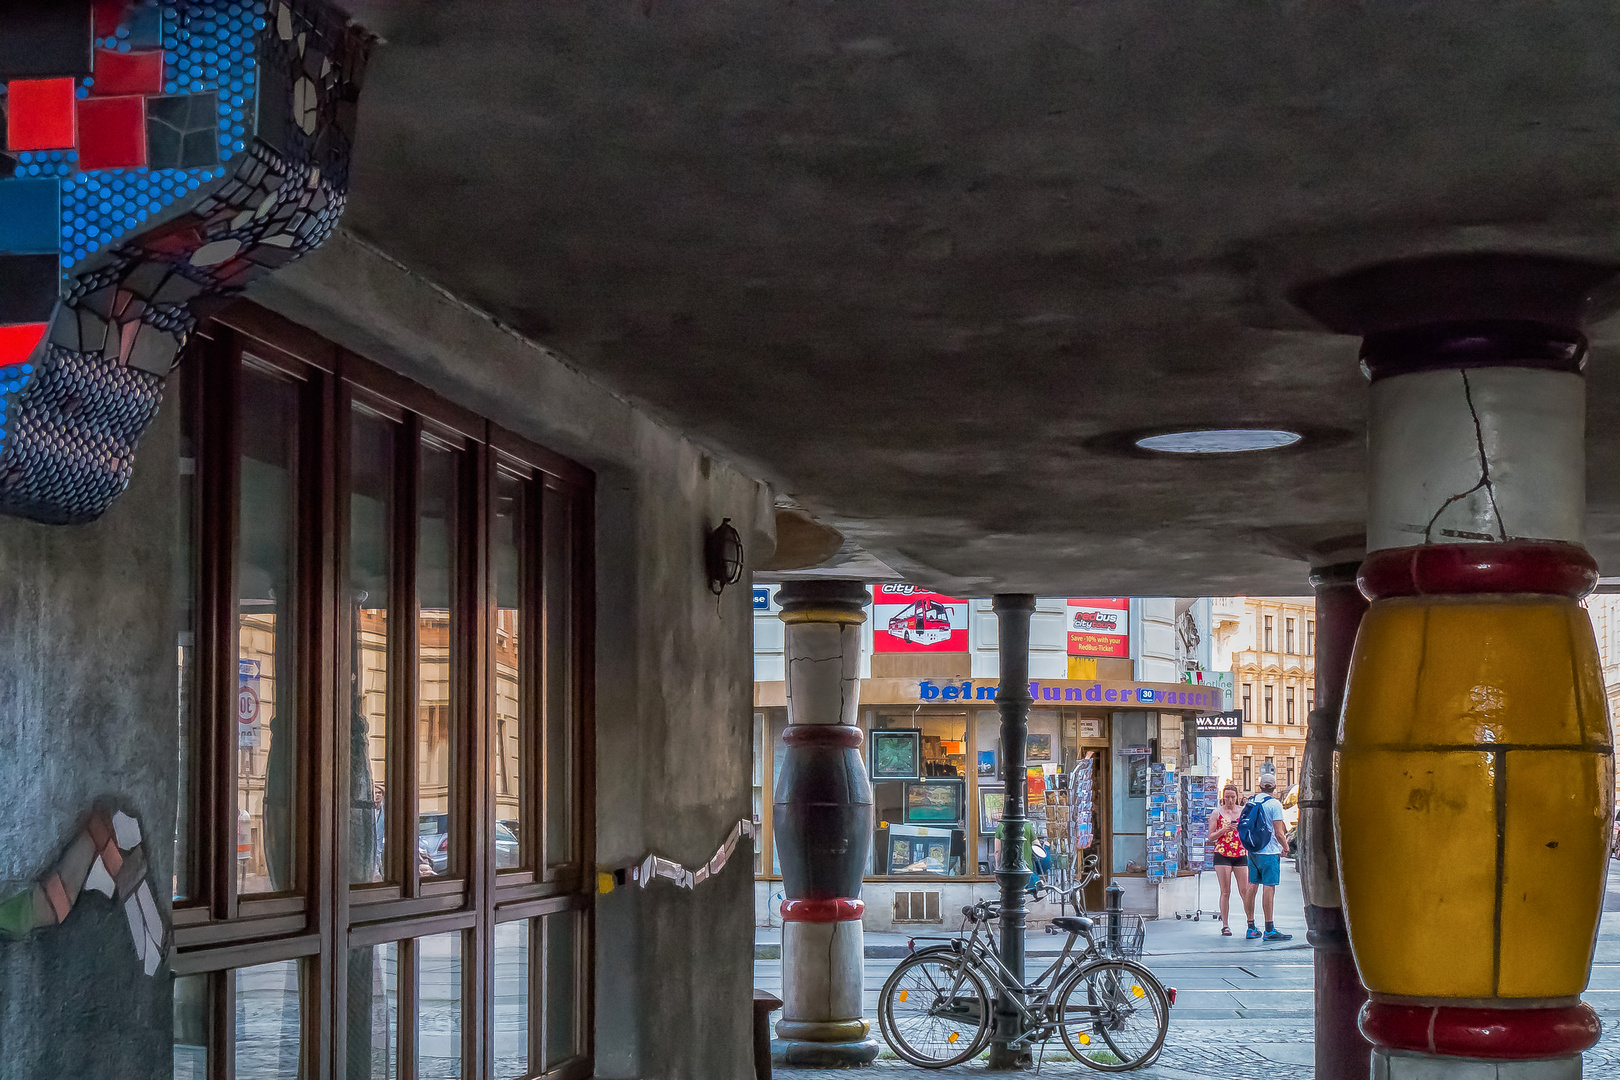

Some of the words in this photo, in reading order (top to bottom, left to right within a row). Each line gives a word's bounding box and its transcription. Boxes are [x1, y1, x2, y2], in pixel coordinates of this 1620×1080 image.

[1075, 611, 1117, 622] redbus
[1071, 634, 1083, 642] Save
[1084, 635, 1096, 643] -10%
[1078, 643, 1114, 652] RedBus-Ticket
[1142, 690, 1153, 698] 30
[1196, 717, 1238, 726] WASABI
